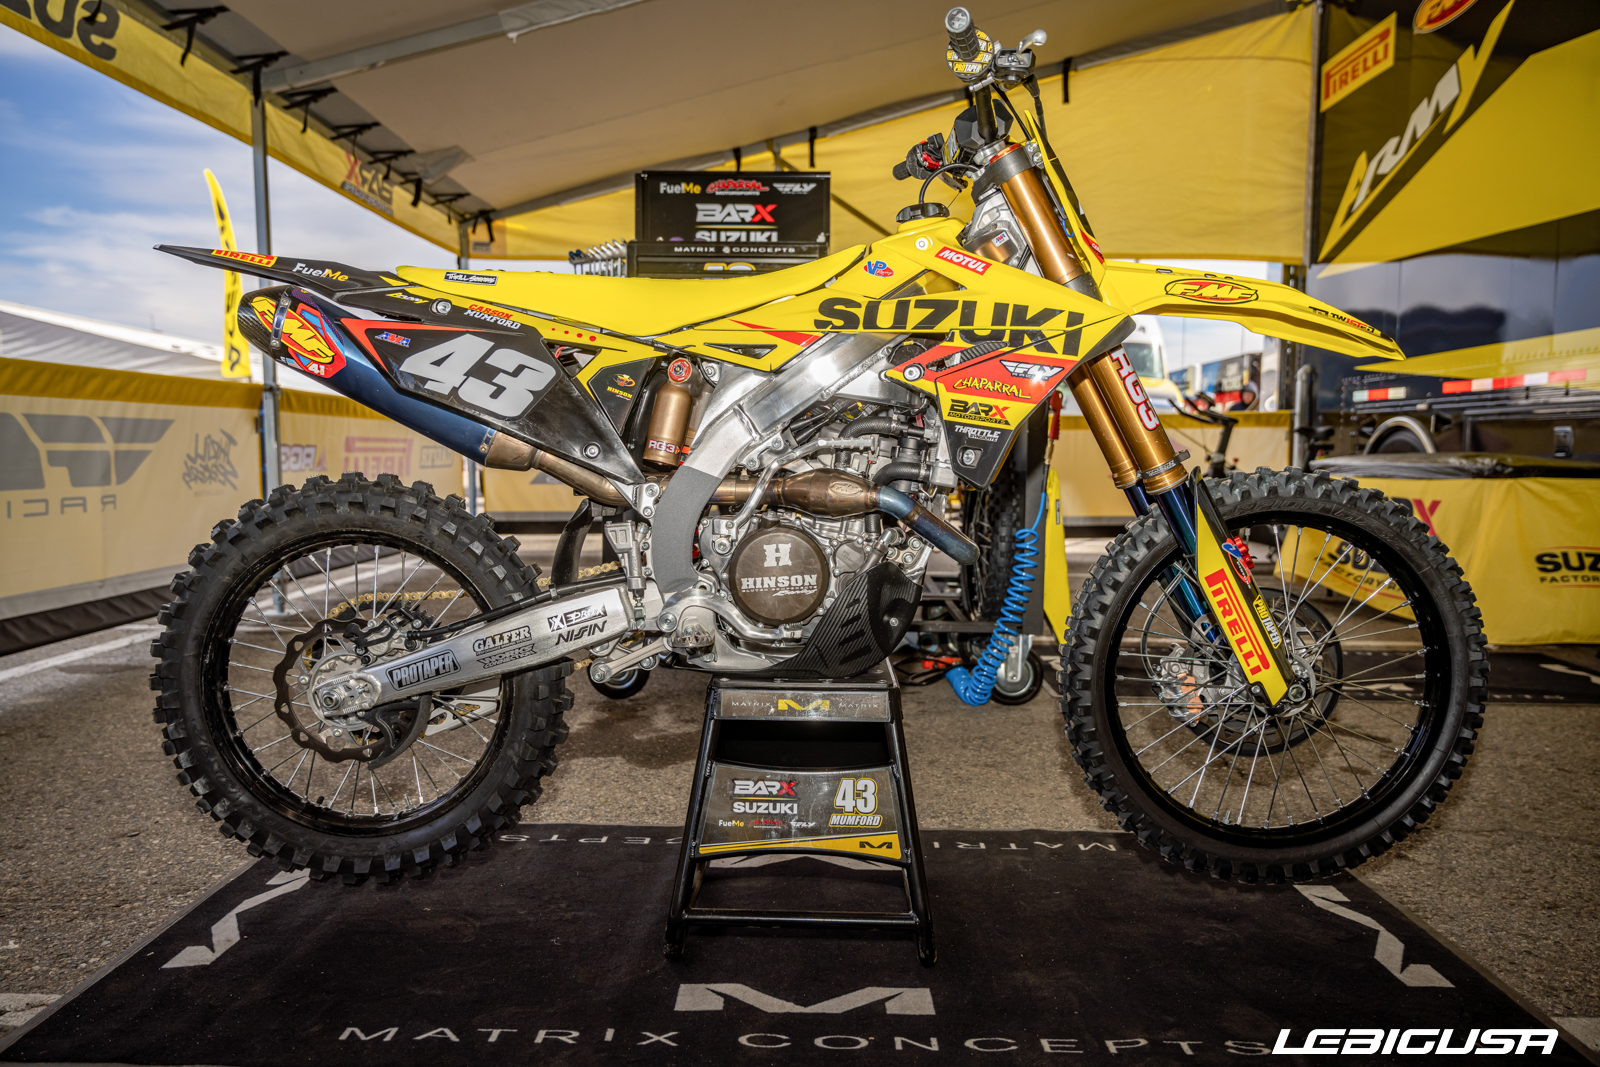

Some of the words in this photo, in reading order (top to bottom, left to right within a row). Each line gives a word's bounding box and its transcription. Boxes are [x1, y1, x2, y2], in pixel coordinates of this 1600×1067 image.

[1324, 27, 1390, 100] PIRELLI
[660, 182, 701, 194] FuelMe
[706, 179, 769, 193] CHAPARRAL
[695, 204, 777, 222] BARX
[214, 250, 275, 265] PIRELLI
[940, 249, 987, 273] MOTUL
[293, 263, 349, 282] FuelMe
[866, 260, 887, 275] VP
[1166, 283, 1258, 299] FMF
[464, 309, 521, 329] MUMFORD
[468, 304, 513, 319] CARSON
[814, 298, 1085, 357] SUZUKI
[375, 332, 411, 347] AMA
[399, 333, 556, 417] 43
[953, 376, 1031, 399] CHAPARRAL
[949, 399, 1010, 419] BARX
[948, 412, 1010, 426] MOTORSPORTS
[954, 424, 1001, 438] THROTTLE
[740, 574, 817, 589] HINSON
[1204, 568, 1270, 676] PIRELLI
[473, 626, 531, 652] GALFER
[555, 620, 607, 646] NISSIN
[733, 780, 797, 795] BARX
[835, 778, 876, 814] 43
[732, 802, 798, 814] SUZUKI
[830, 814, 882, 826] MUMFORD
[338, 1027, 679, 1046] MATRIX
[738, 1033, 1272, 1056] CONCEPTS
